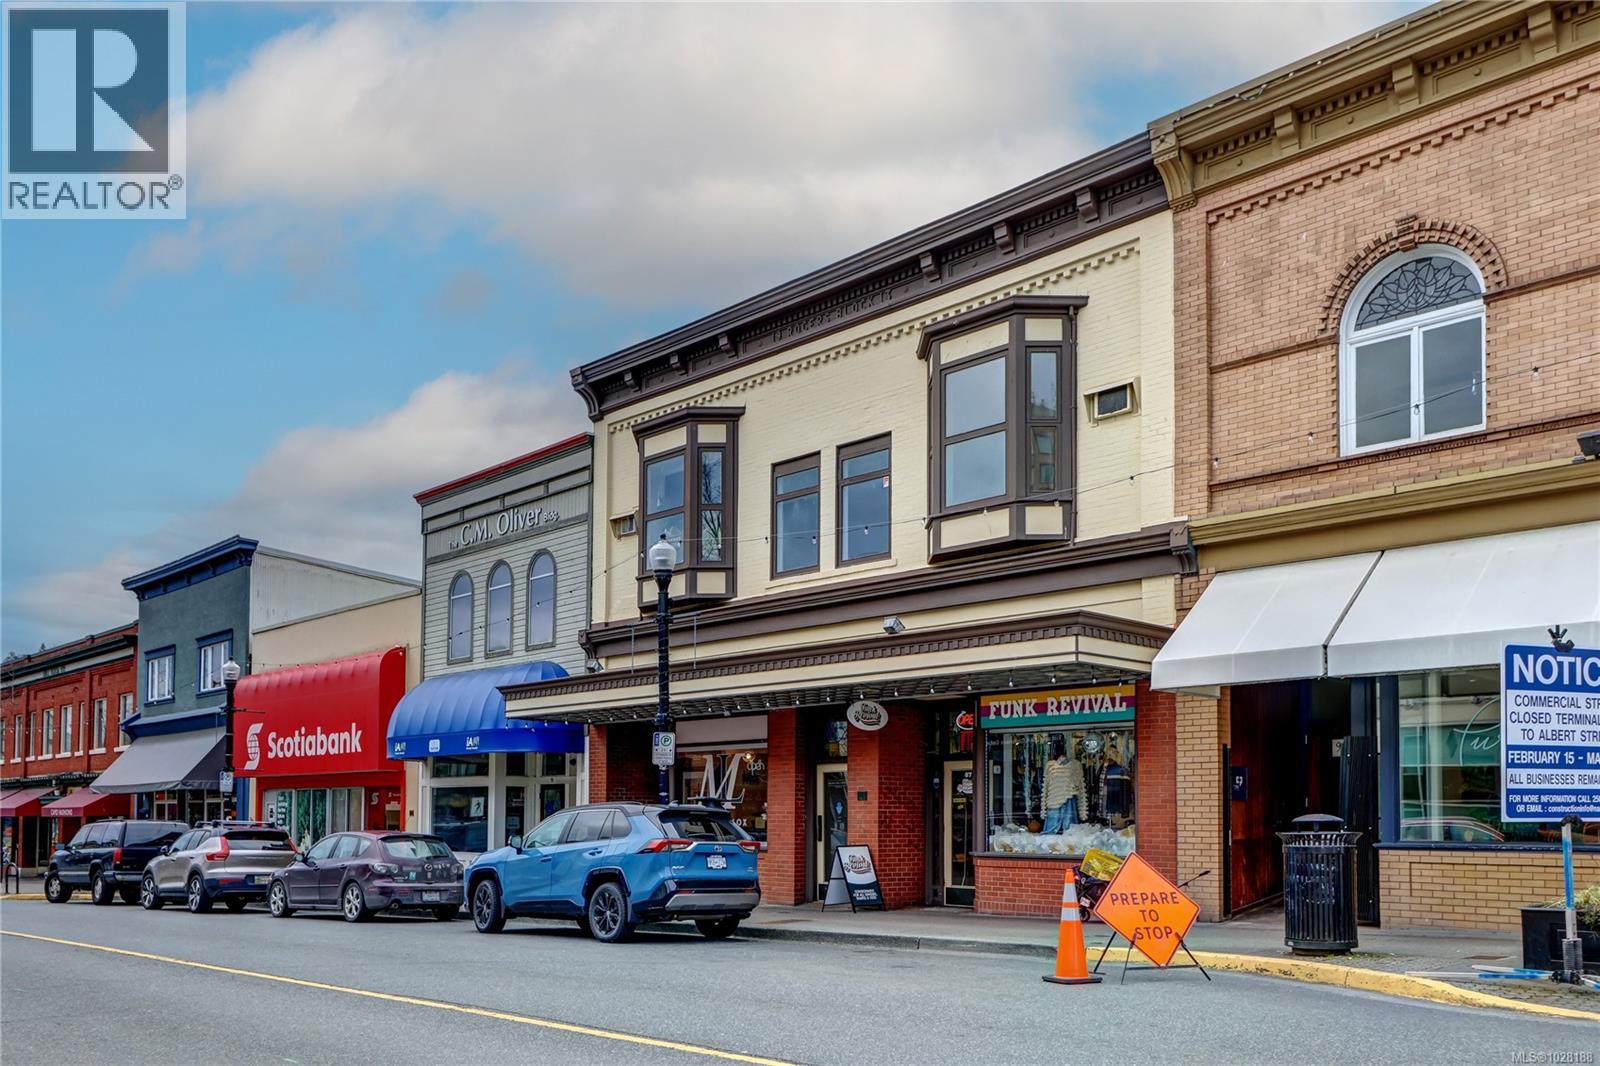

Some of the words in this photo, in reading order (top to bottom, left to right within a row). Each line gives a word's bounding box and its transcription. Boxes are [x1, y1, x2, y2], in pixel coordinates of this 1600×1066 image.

[787, 311, 831, 337] ROGERS
[835, 295, 875, 318] BLOCK
[460, 518, 493, 546] C.M.
[496, 507, 542, 536] Oliver
[1513, 653, 1600, 687] NOTIC
[989, 698, 1039, 720] FUNK
[1047, 692, 1127, 717] REVIVAL
[1514, 694, 1582, 709] COMMERCIAL
[1509, 711, 1552, 724] CLOSED
[267, 722, 363, 760] Scotiabank
[1520, 728, 1535, 741] TO
[1538, 729, 1576, 742] ALBERT
[1508, 750, 1561, 764] FEBRUARY
[1563, 752, 1575, 765] 15
[1509, 773, 1524, 785] ALL
[1526, 774, 1576, 786] BUSINESSES
[1509, 794, 1521, 803] FOR
[1522, 794, 1540, 803] MORE
[1540, 794, 1577, 803] INFORMATION
[1577, 795, 1591, 804] CALL
[1516, 805, 1526, 813] OR
[1526, 805, 1544, 813] EMAIL
[1109, 891, 1180, 906] PREPARE
[1138, 909, 1160, 923] TO
[1134, 925, 1173, 941] STOP
